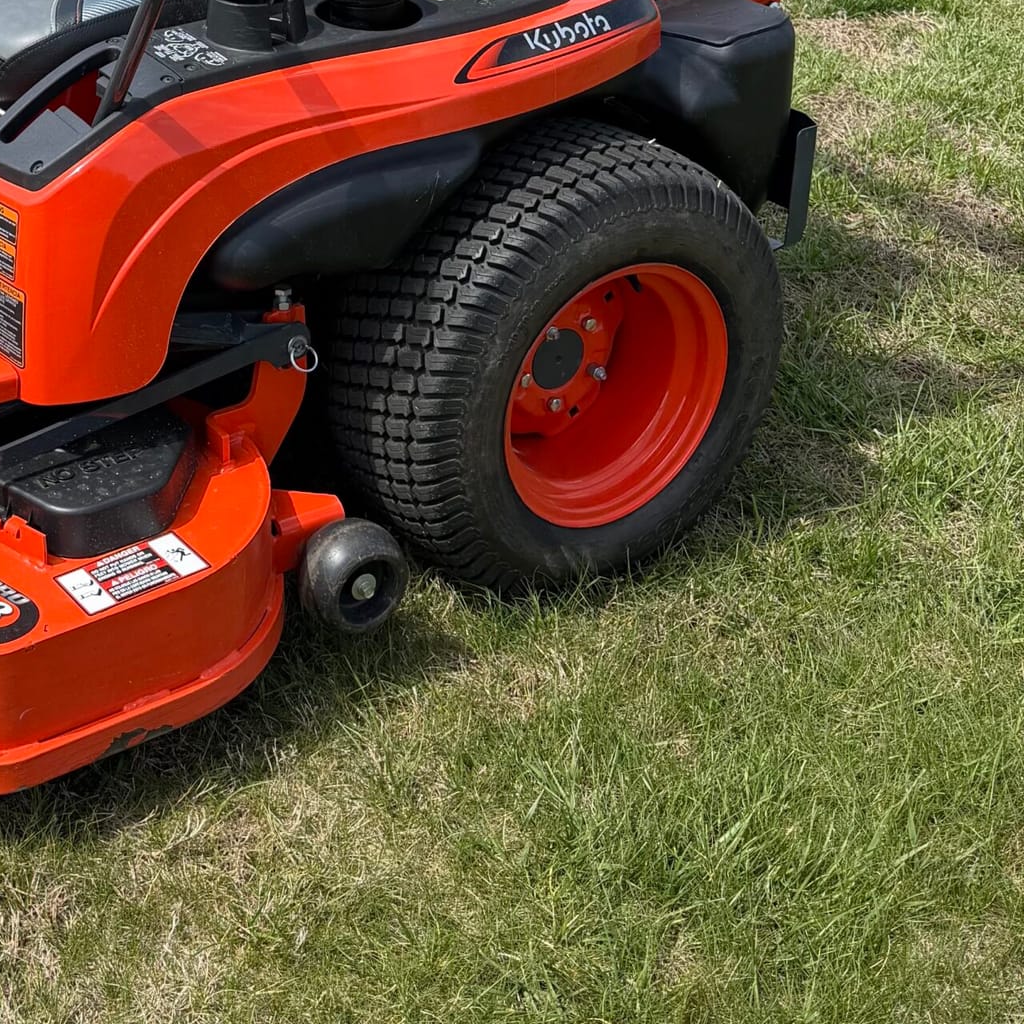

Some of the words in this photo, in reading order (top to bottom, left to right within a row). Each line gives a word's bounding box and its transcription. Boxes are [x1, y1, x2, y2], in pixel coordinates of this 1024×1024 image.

[523, 12, 611, 52] Kubota
[36, 467, 76, 489] NO
[78, 447, 144, 475] STEP
[103, 546, 139, 563] DANGER
[118, 564, 158, 584] PELIGRO
